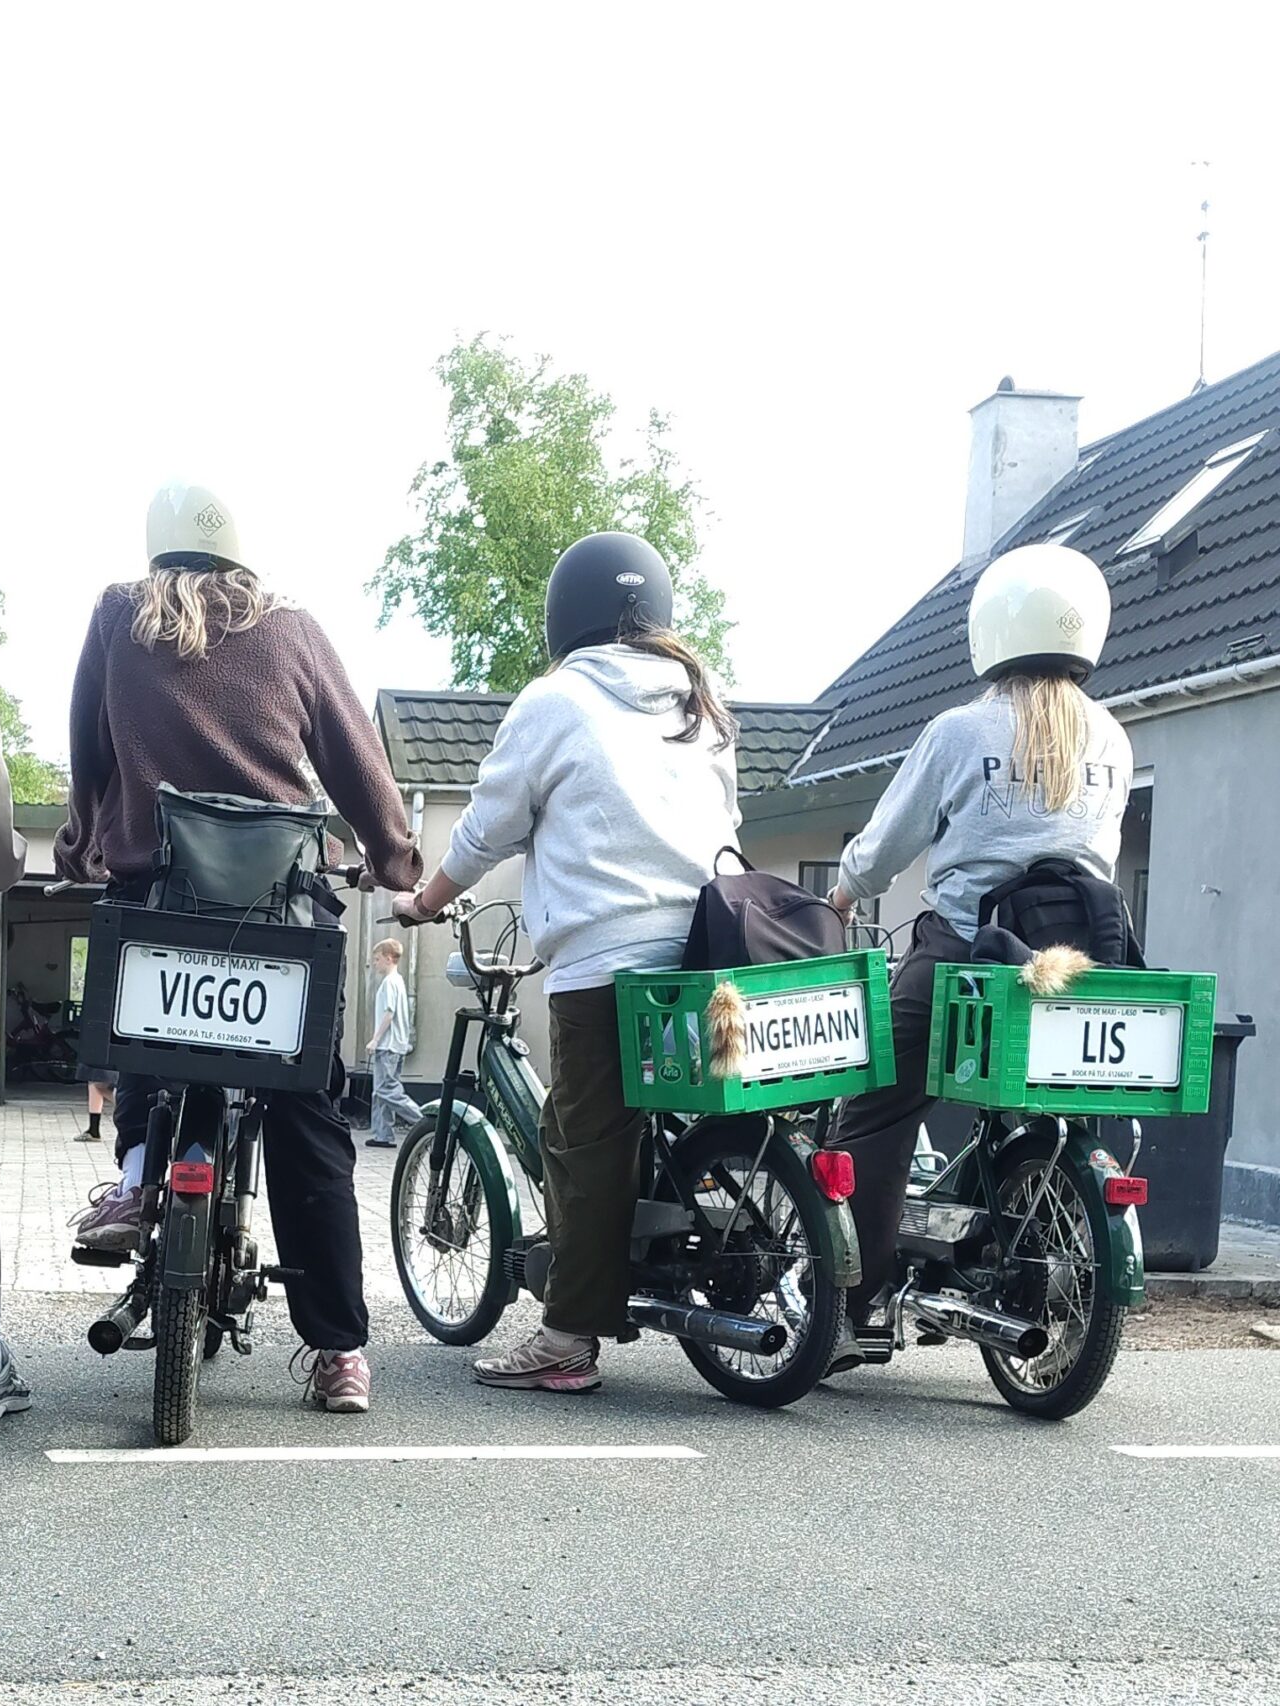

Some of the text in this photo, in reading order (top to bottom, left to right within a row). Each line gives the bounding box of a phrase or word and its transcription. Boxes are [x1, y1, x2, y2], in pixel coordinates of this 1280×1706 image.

[177, 951, 260, 971] TOUR DE MAXI
[160, 970, 267, 1025] VIGGO
[1076, 1007, 1091, 1015] TOUR
[1093, 1007, 1100, 1015] DE
[166, 1026, 188, 1036] BOOK
[189, 1028, 199, 1038] PÅ
[217, 1032, 252, 1043] 61266267
[743, 1008, 859, 1055] INGEMANN
[1082, 1020, 1126, 1064] LIS
[558, 1351, 592, 1369] SALOMON
